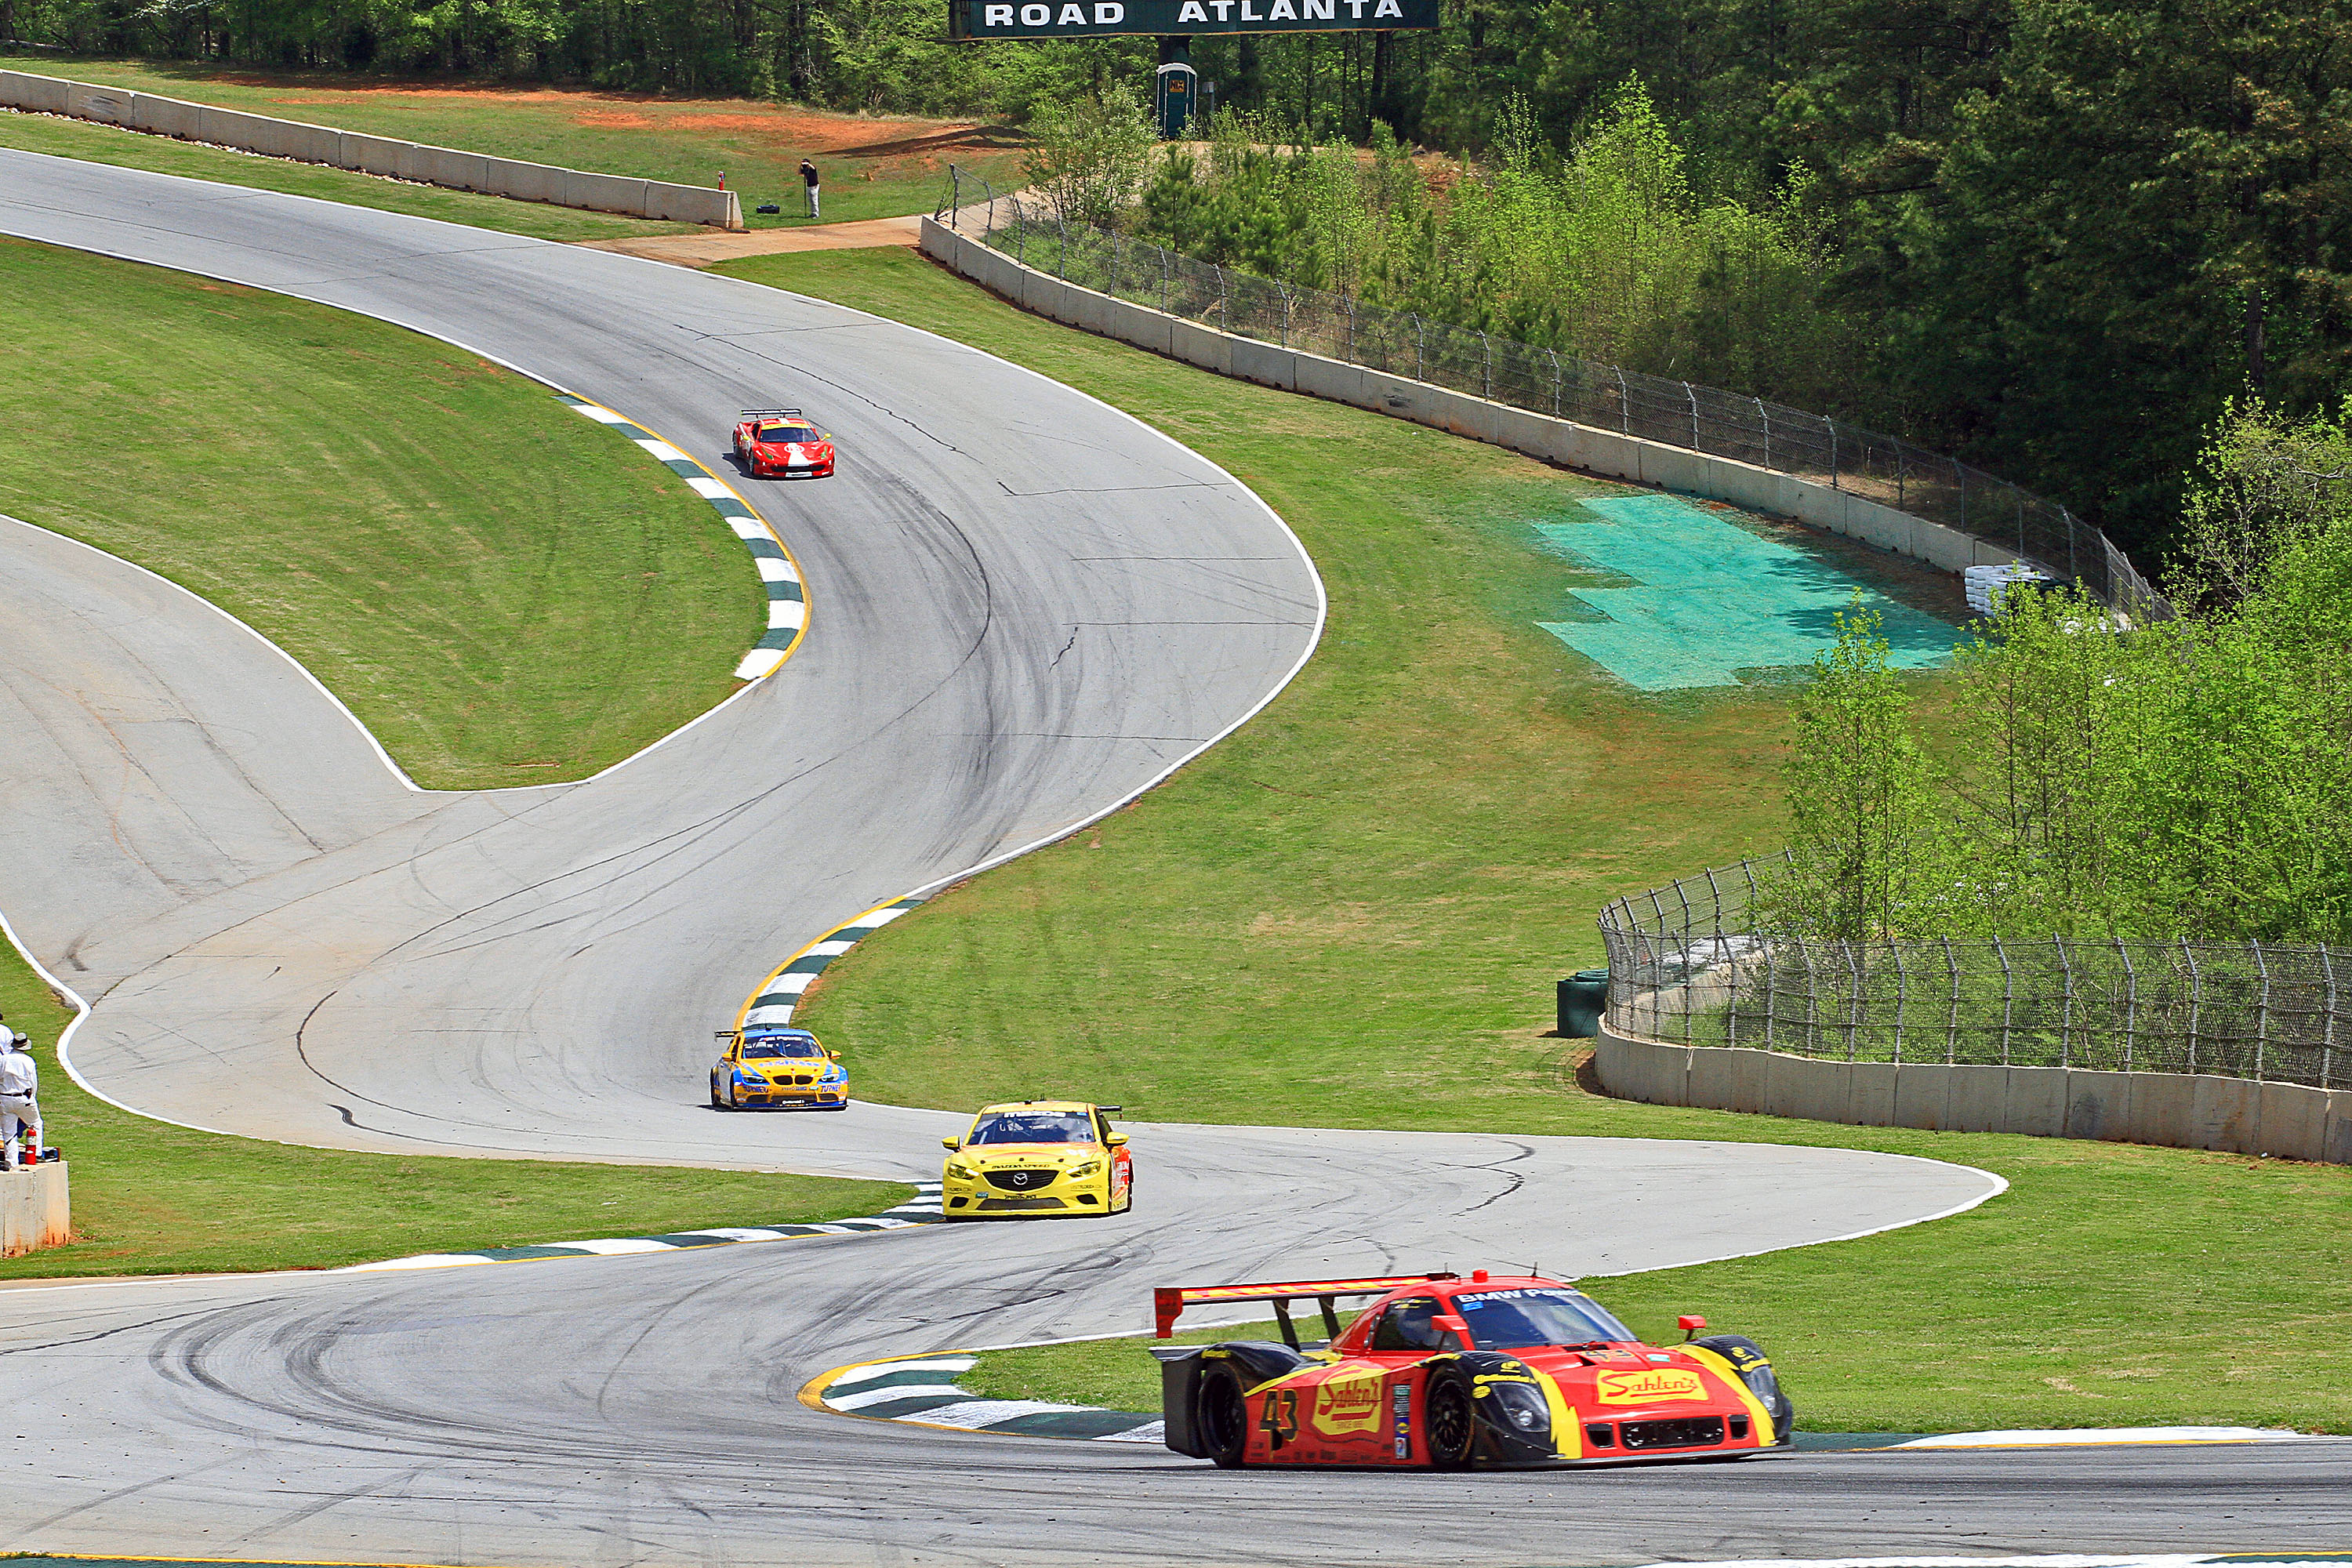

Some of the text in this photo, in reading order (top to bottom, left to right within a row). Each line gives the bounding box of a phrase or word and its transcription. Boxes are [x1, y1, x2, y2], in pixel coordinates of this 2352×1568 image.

[985, 0, 1403, 27] ROAD ATLANTA
[1456, 1289, 1523, 1303] BMW
[1318, 1369, 1380, 1421] Sahlen's
[1600, 1372, 1698, 1398] Sahlen's
[1259, 1388, 1298, 1451] 43
